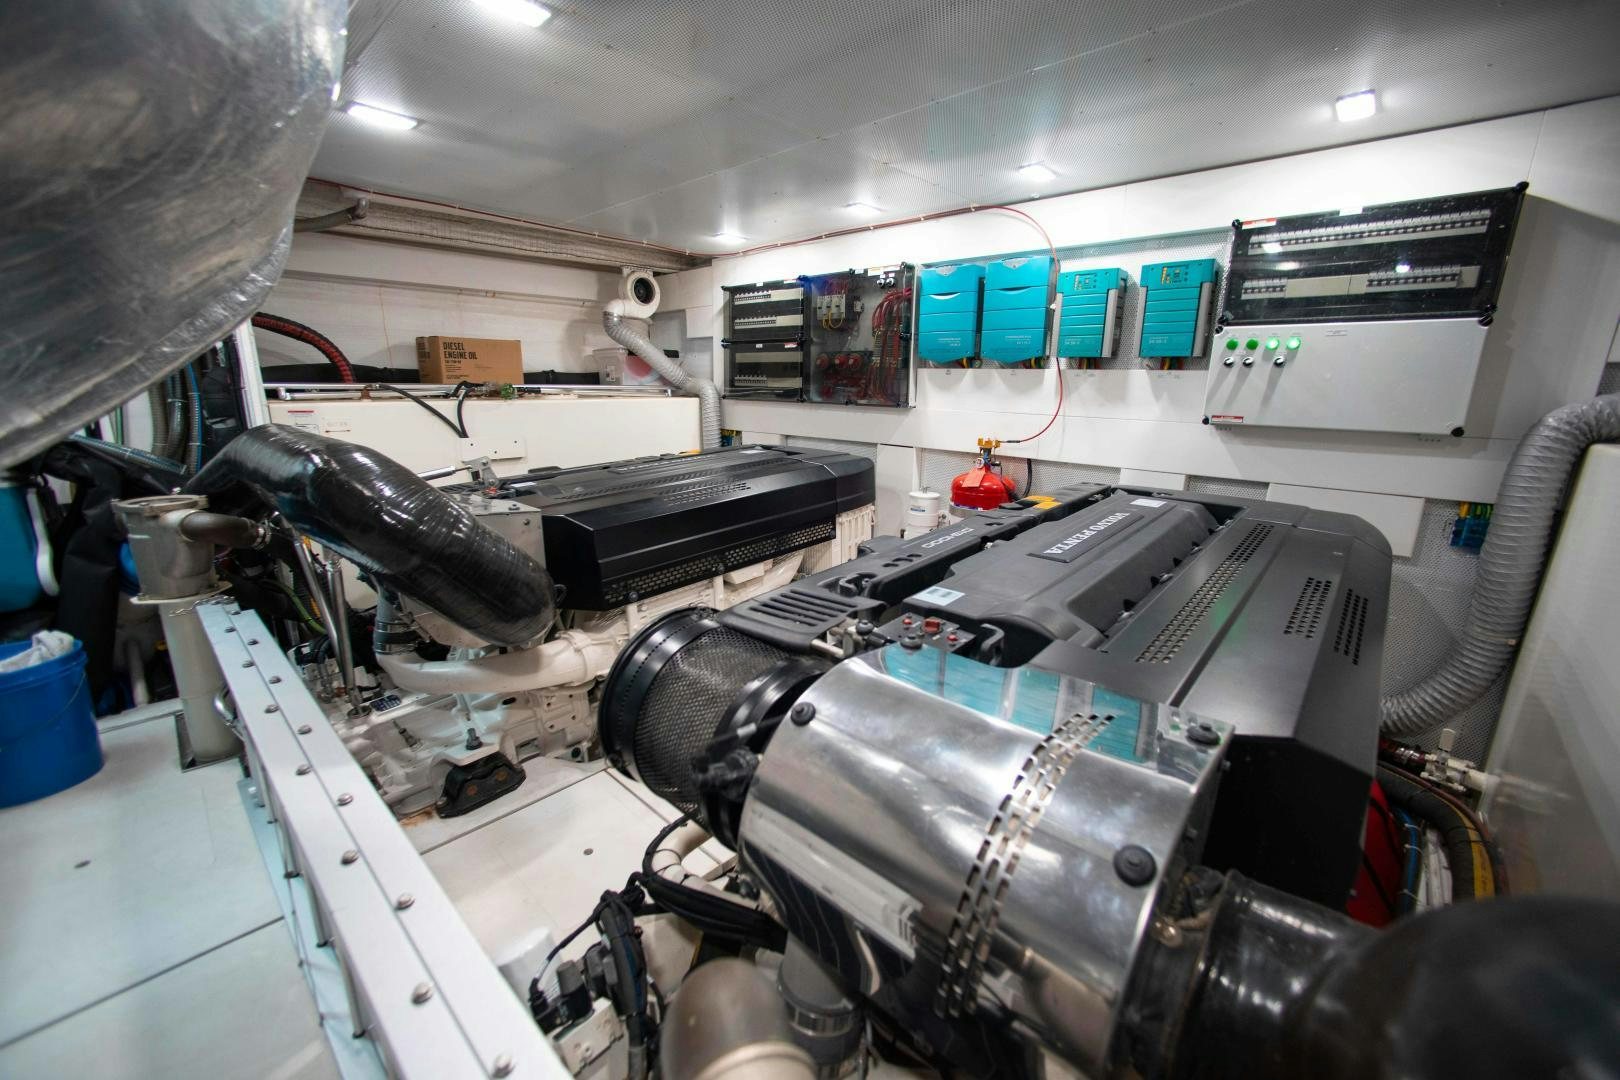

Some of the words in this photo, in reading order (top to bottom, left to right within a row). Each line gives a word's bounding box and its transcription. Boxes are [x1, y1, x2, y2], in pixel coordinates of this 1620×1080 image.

[444, 342, 464, 350] DIESEL
[444, 351, 468, 359] ENGINE
[469, 352, 478, 360] OIL
[1089, 513, 1130, 531] VOLVO
[1042, 530, 1096, 555] PENTA
